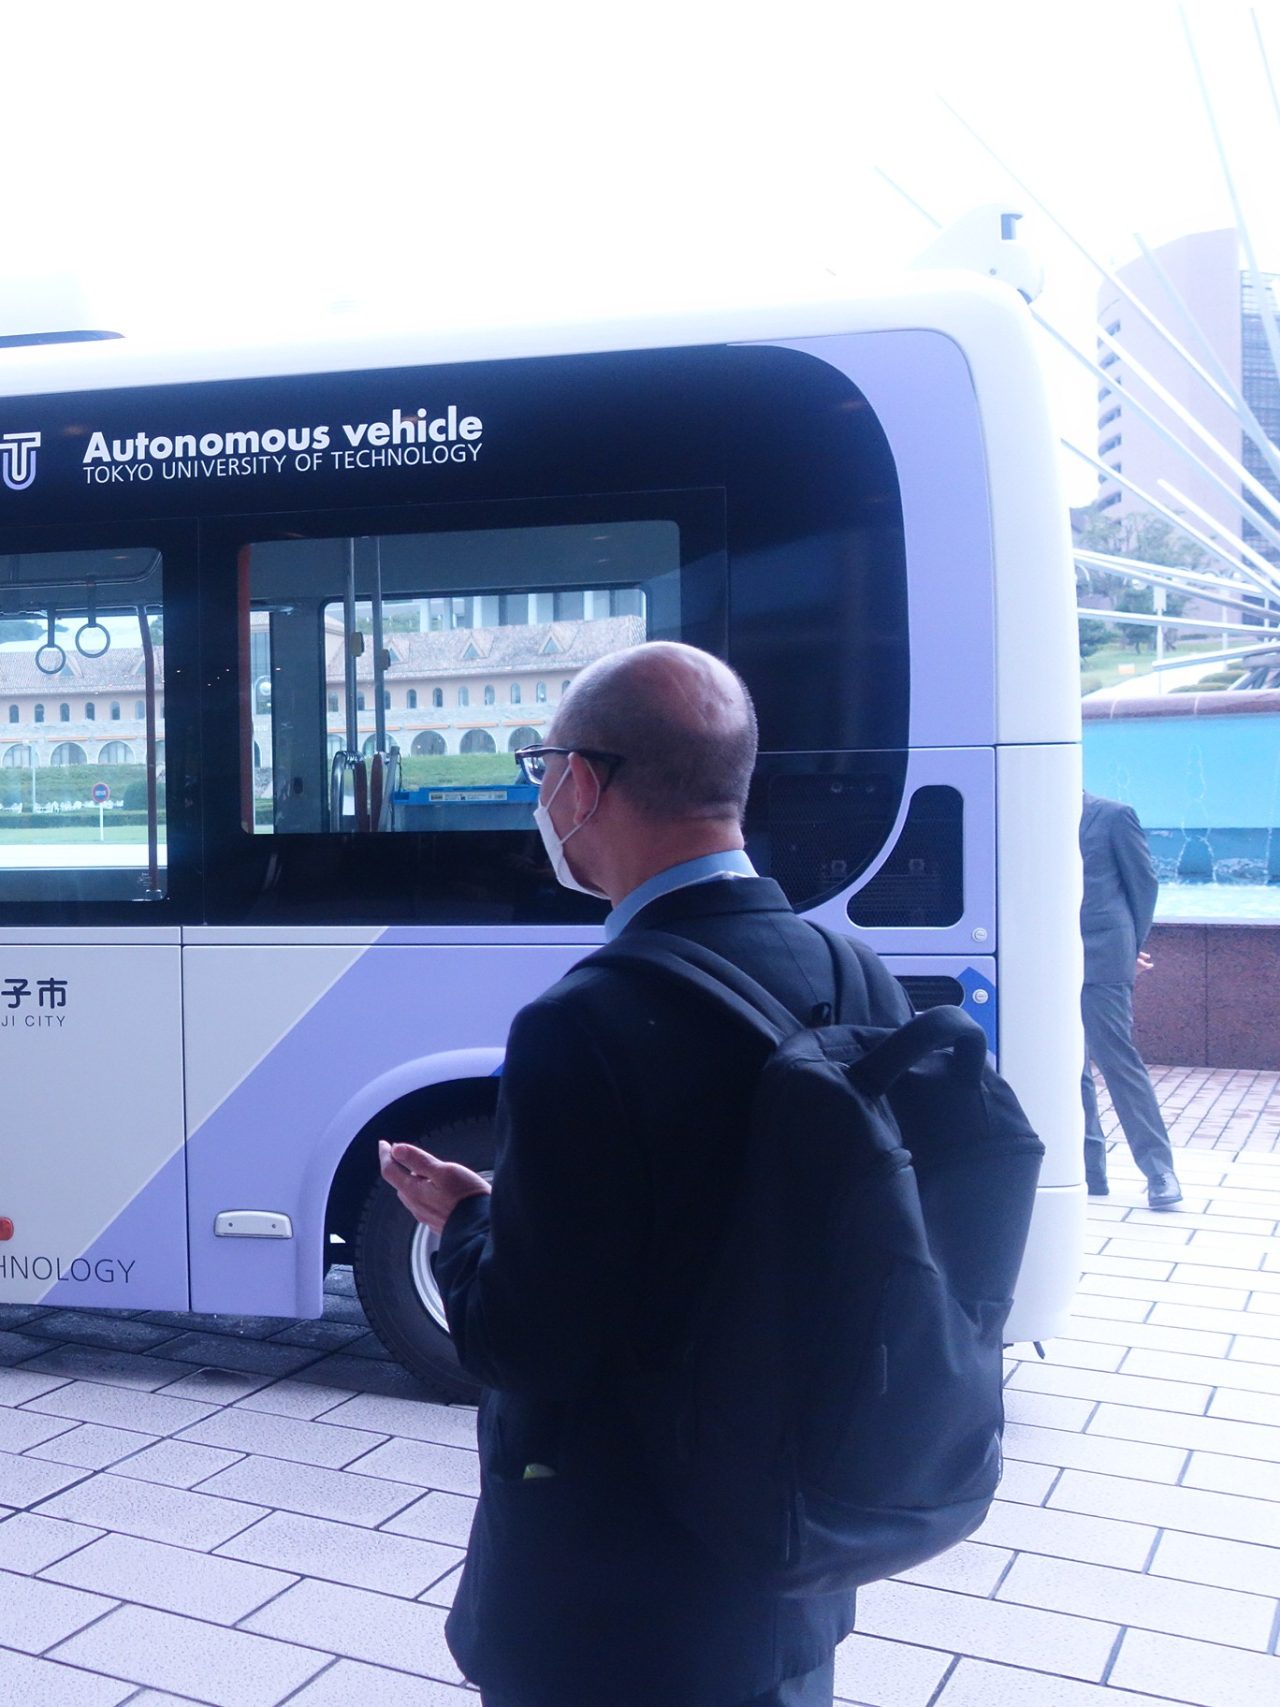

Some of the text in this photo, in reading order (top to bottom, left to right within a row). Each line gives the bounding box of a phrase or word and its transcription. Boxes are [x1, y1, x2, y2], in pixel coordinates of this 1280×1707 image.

[82, 405, 483, 463] Autonomous vehicle
[82, 443, 483, 484] TOKYO UNIVERSITY OF TECHNOLOGY
[24, 1015, 66, 1027] CITY
